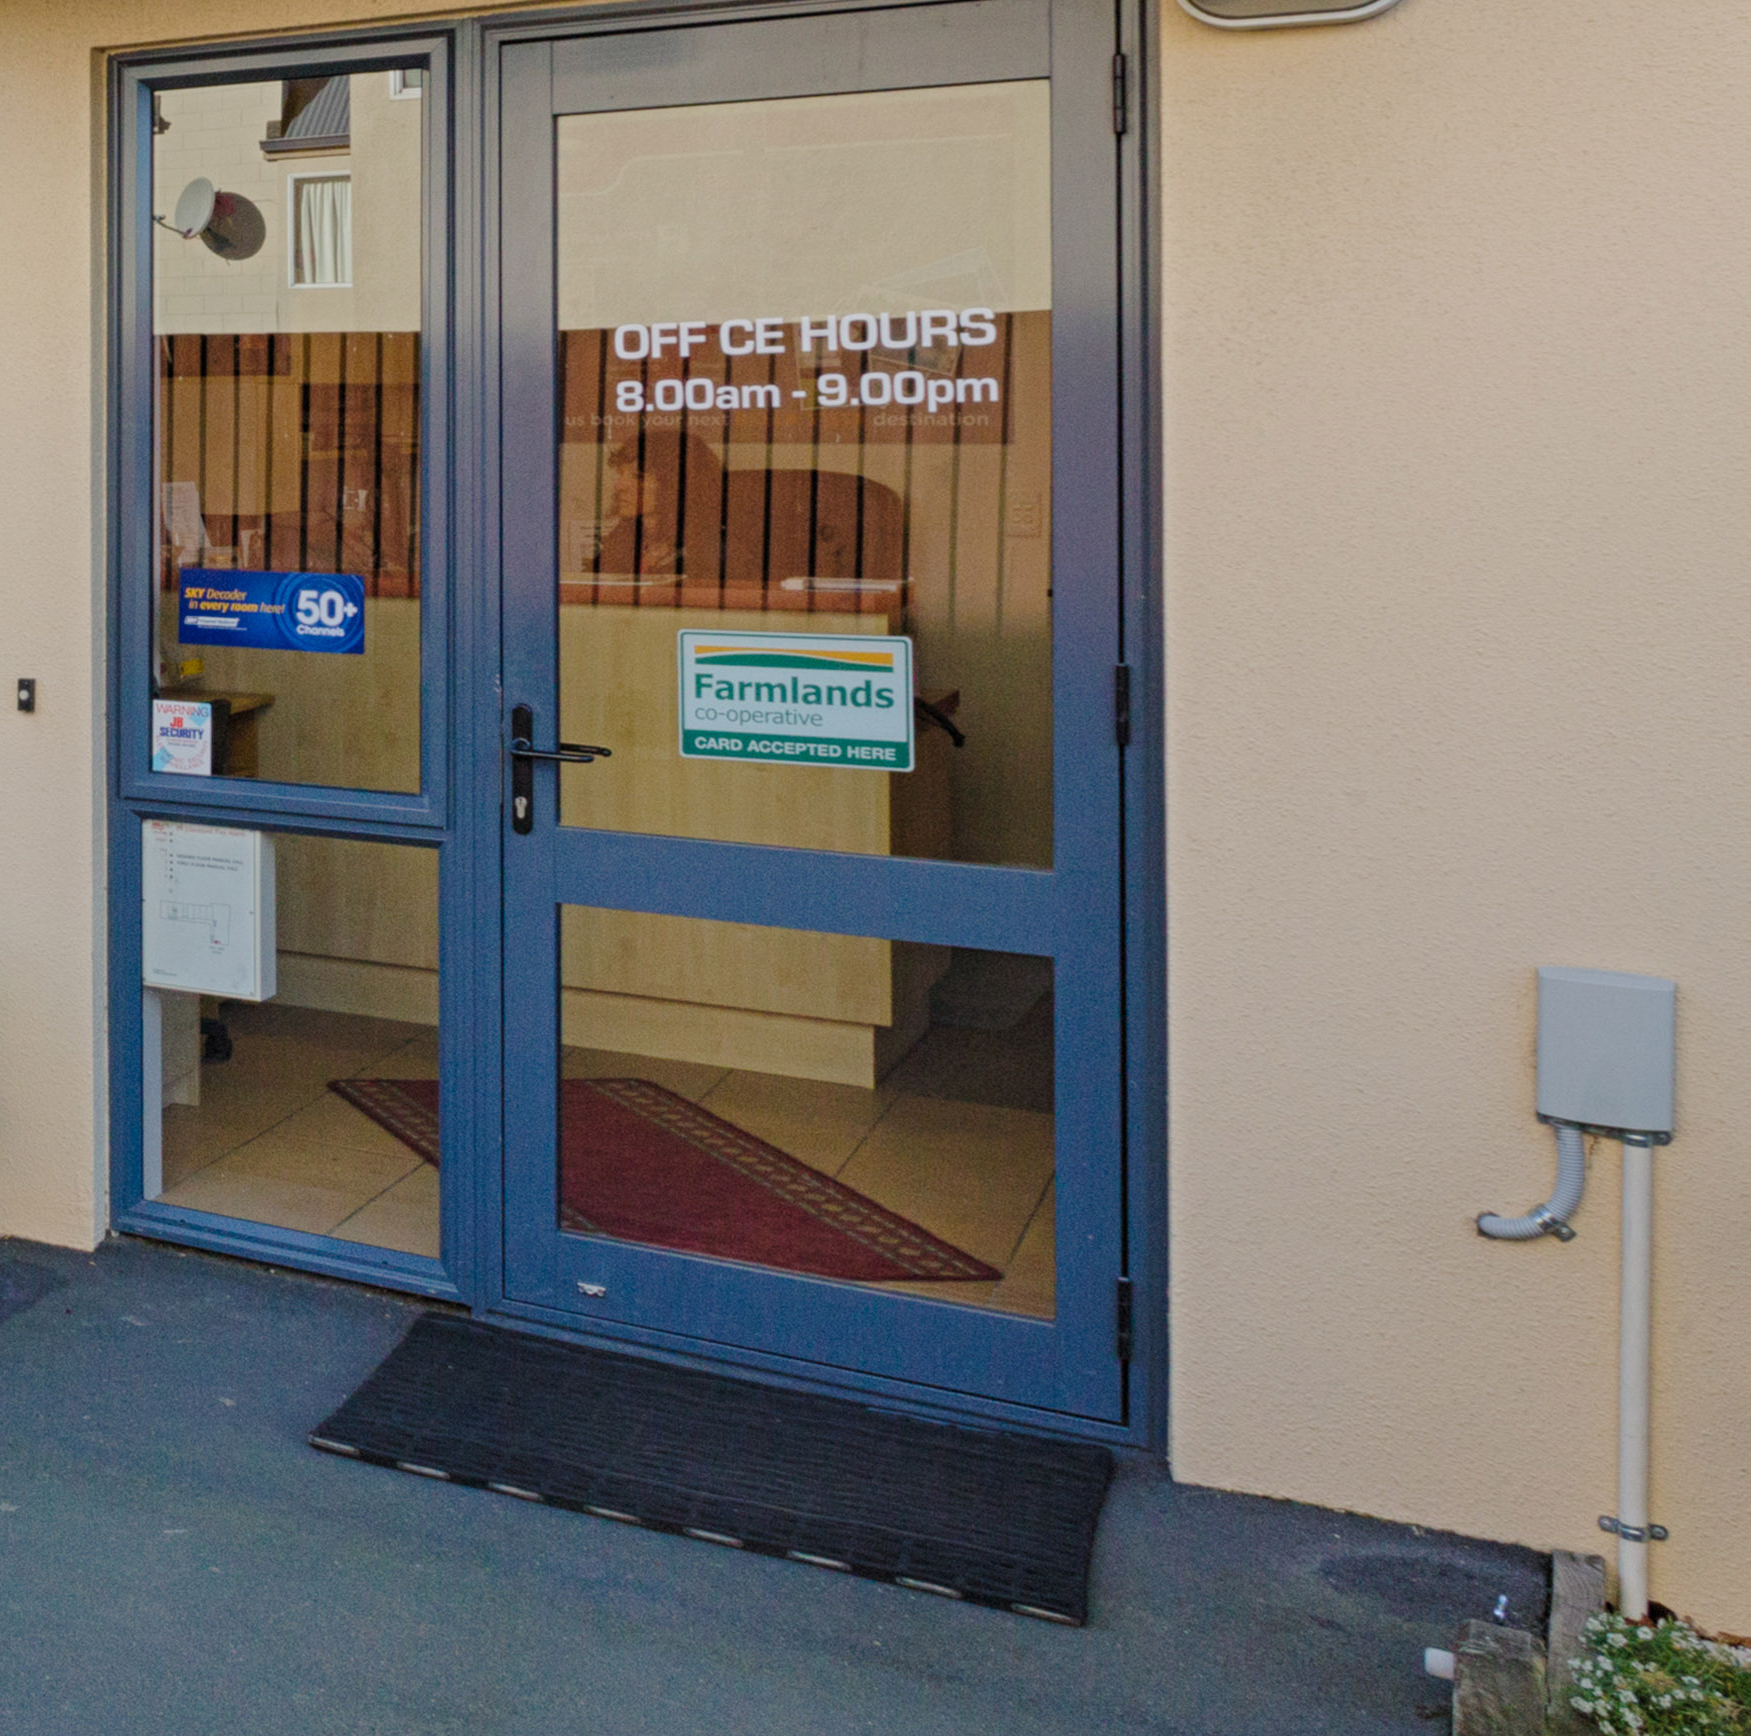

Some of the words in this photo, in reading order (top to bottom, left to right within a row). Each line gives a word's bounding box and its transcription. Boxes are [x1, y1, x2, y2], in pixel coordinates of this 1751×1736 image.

[800, 307, 997, 353] HOURS
[616, 377, 781, 412] 8.00am
[817, 371, 999, 413] 9.00pm
[184, 587, 205, 599] SKY
[206, 588, 247, 601] Decoder
[188, 599, 199, 610] in
[199, 601, 230, 614] every
[230, 602, 259, 613] room
[296, 590, 359, 626] 50+
[295, 624, 346, 638] Channels
[694, 672, 895, 709] Farmlands
[155, 703, 210, 718] WARNING
[694, 706, 824, 727] co-operative
[170, 716, 184, 728] JB
[159, 726, 204, 740] SECURITY
[694, 736, 743, 752] CARD
[747, 739, 842, 758] ACCEPTED
[846, 745, 897, 761] HERE
